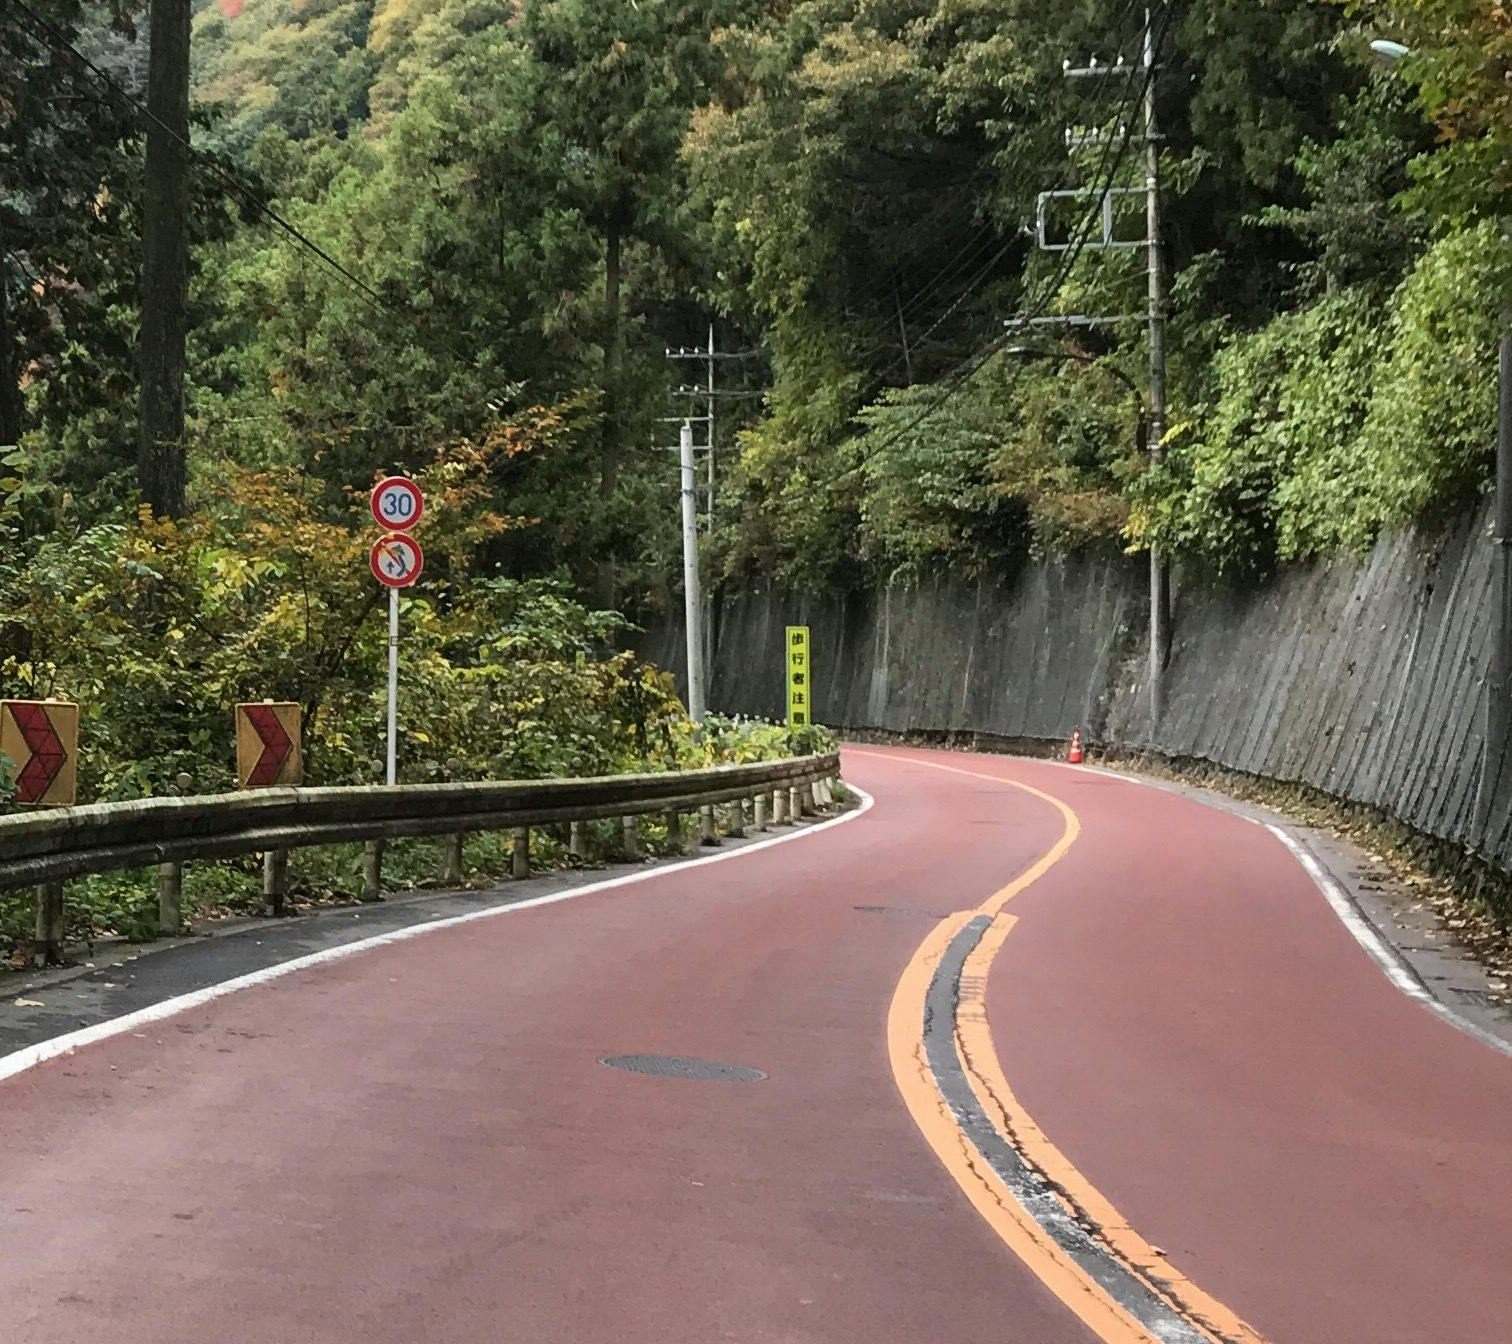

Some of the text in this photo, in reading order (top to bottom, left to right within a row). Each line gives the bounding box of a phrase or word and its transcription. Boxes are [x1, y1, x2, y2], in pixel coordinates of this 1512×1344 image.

[384, 493, 412, 516] 30
[791, 632, 805, 725] 歩行者注意
